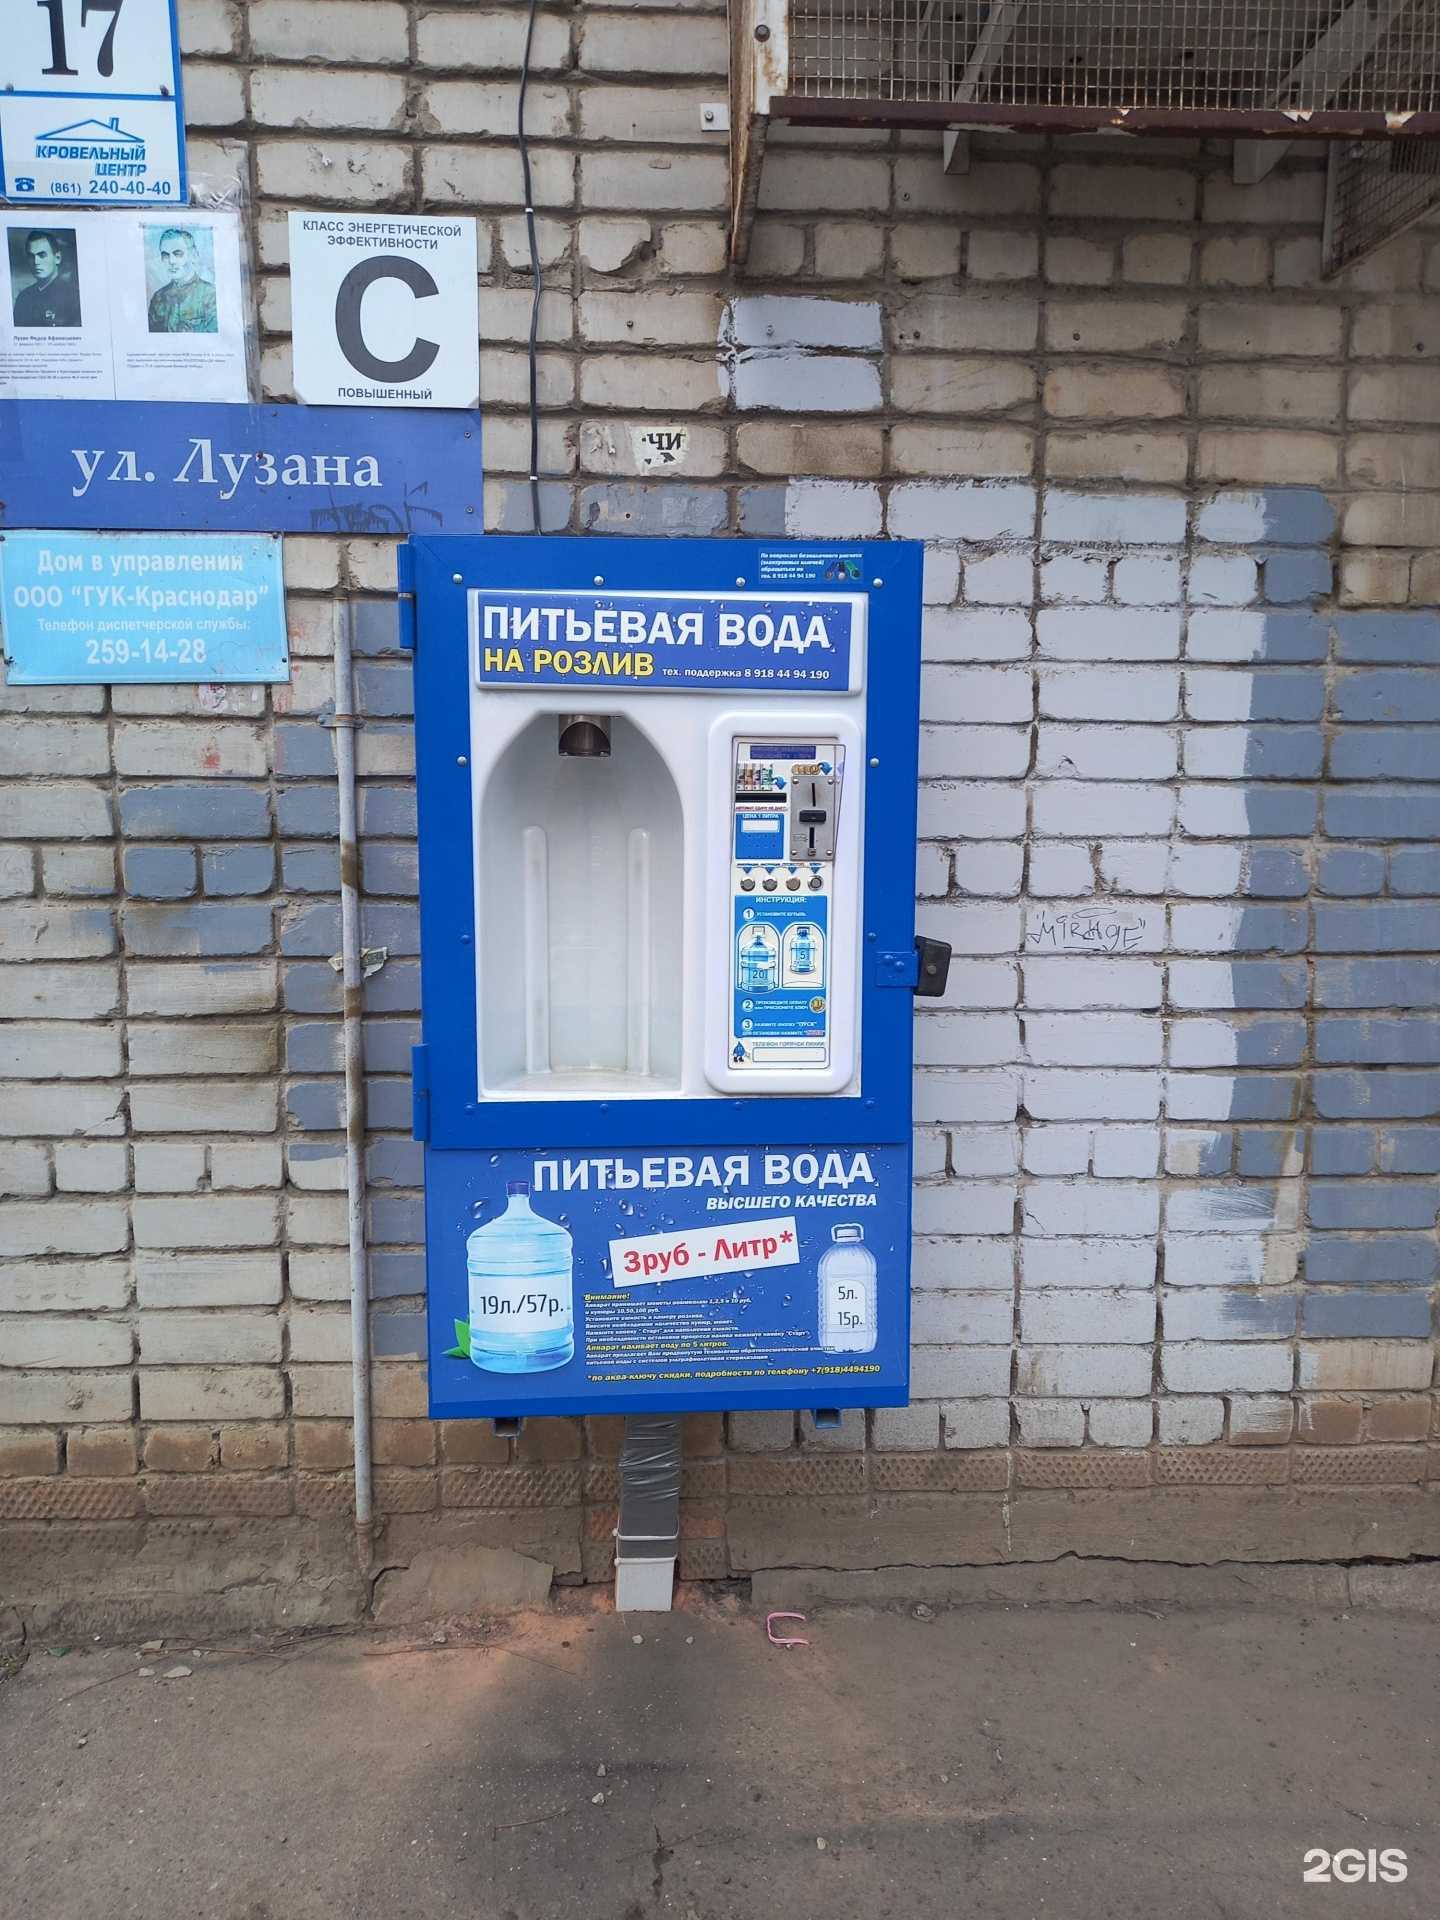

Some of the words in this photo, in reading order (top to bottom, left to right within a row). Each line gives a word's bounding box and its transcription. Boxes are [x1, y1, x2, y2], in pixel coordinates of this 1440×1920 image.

[37, 0, 122, 77] 17
[35, 145, 147, 161] КРОВЕЛЬНЫЙ
[95, 162, 147, 178] ЦЕНТР
[50, 183, 82, 196] (861)
[89, 180, 171, 196] 240-40-40
[303, 220, 344, 234] КЛАСС
[347, 221, 462, 237] ЭНЕРГЕТИЧЕСКОЙ
[327, 236, 438, 250] ЭФФЕКТИВНОСТИ
[337, 386, 432, 400] ПОВЫШЕННЫЙ
[72, 448, 155, 497] ул.
[173, 438, 382, 499] Лузана
[38, 550, 83, 576] Дом
[91, 555, 104, 571] в
[110, 554, 243, 576] управлении
[14, 585, 63, 608] ООО
[36, 618, 94, 633] Телефон
[97, 619, 193, 632] диспетчерской
[483, 605, 704, 645] ПИТЬЕВАЯ
[719, 613, 832, 654] ВОДА
[86, 638, 207, 664] 259-14-28
[484, 648, 524, 672] НА
[534, 649, 654, 677] РОЗЛИВ
[662, 668, 681, 677] тех.
[684, 669, 742, 680] поддержка
[744, 669, 751, 678] 8
[754, 669, 774, 678] 918
[776, 670, 790, 678] 44
[793, 670, 806, 679] 94
[809, 670, 829, 680] 190
[533, 1155, 749, 1192] ПИТЬЕВАЯ
[764, 1152, 874, 1187] ВОДА
[706, 1195, 791, 1210] ВЫСШЕГО
[795, 1193, 877, 1208] КАЧЕСТВА
[838, 1286, 858, 1300] 5л.
[480, 1293, 565, 1316] 19л./57р.
[838, 1311, 863, 1328] 15р.
[695, 1369, 752, 1378] подробности
[768, 1367, 808, 1375] телефону
